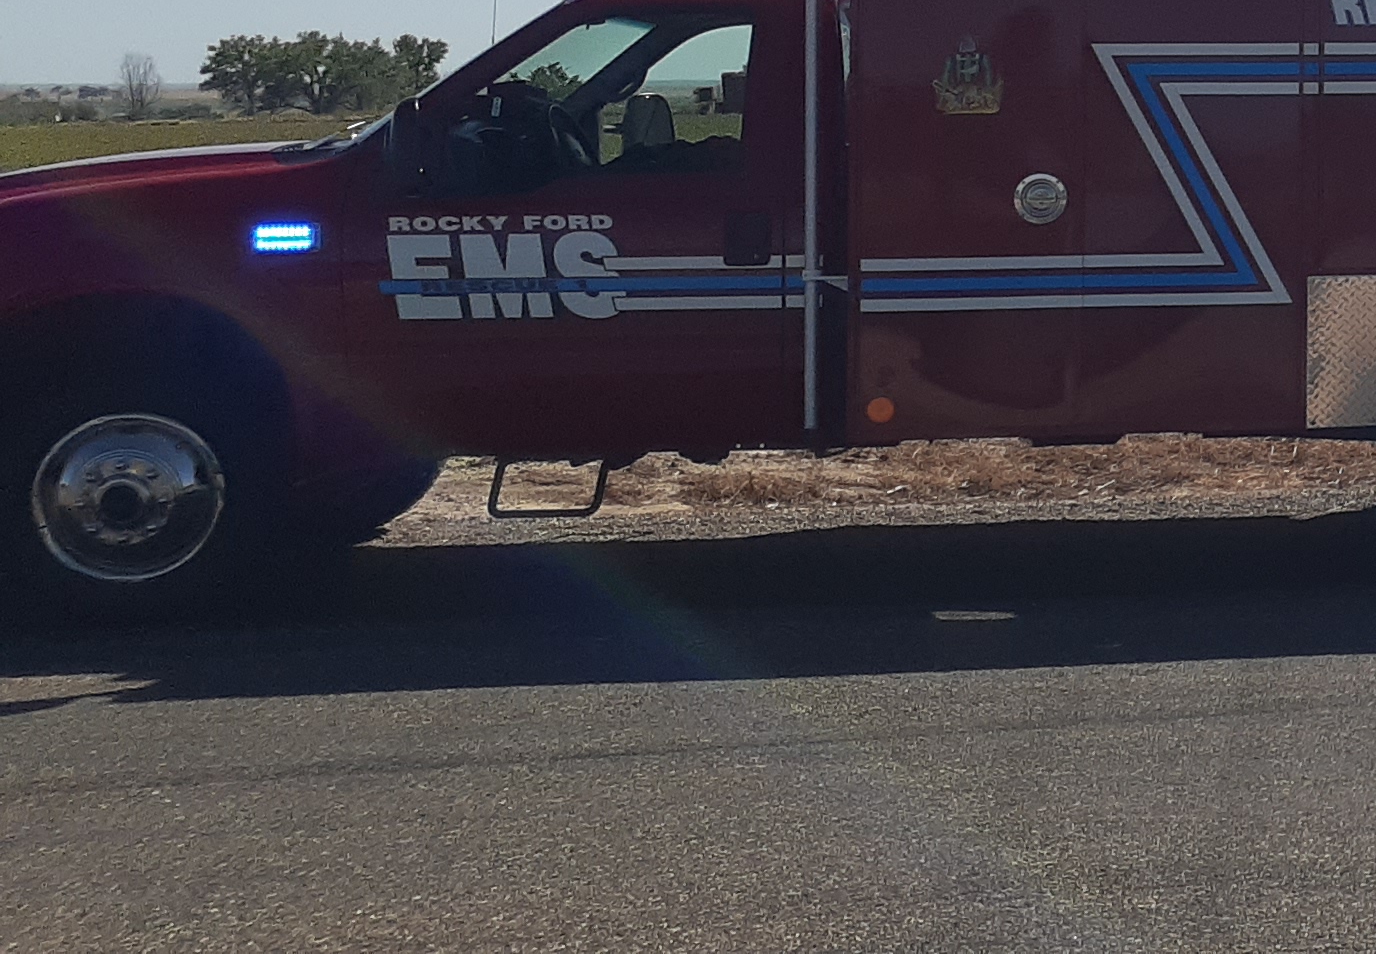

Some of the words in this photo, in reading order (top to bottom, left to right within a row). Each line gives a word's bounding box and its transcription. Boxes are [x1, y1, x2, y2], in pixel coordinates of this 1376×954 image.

[388, 216, 508, 231] ROCKY
[523, 215, 613, 230] FORD
[386, 231, 625, 320] EMS
